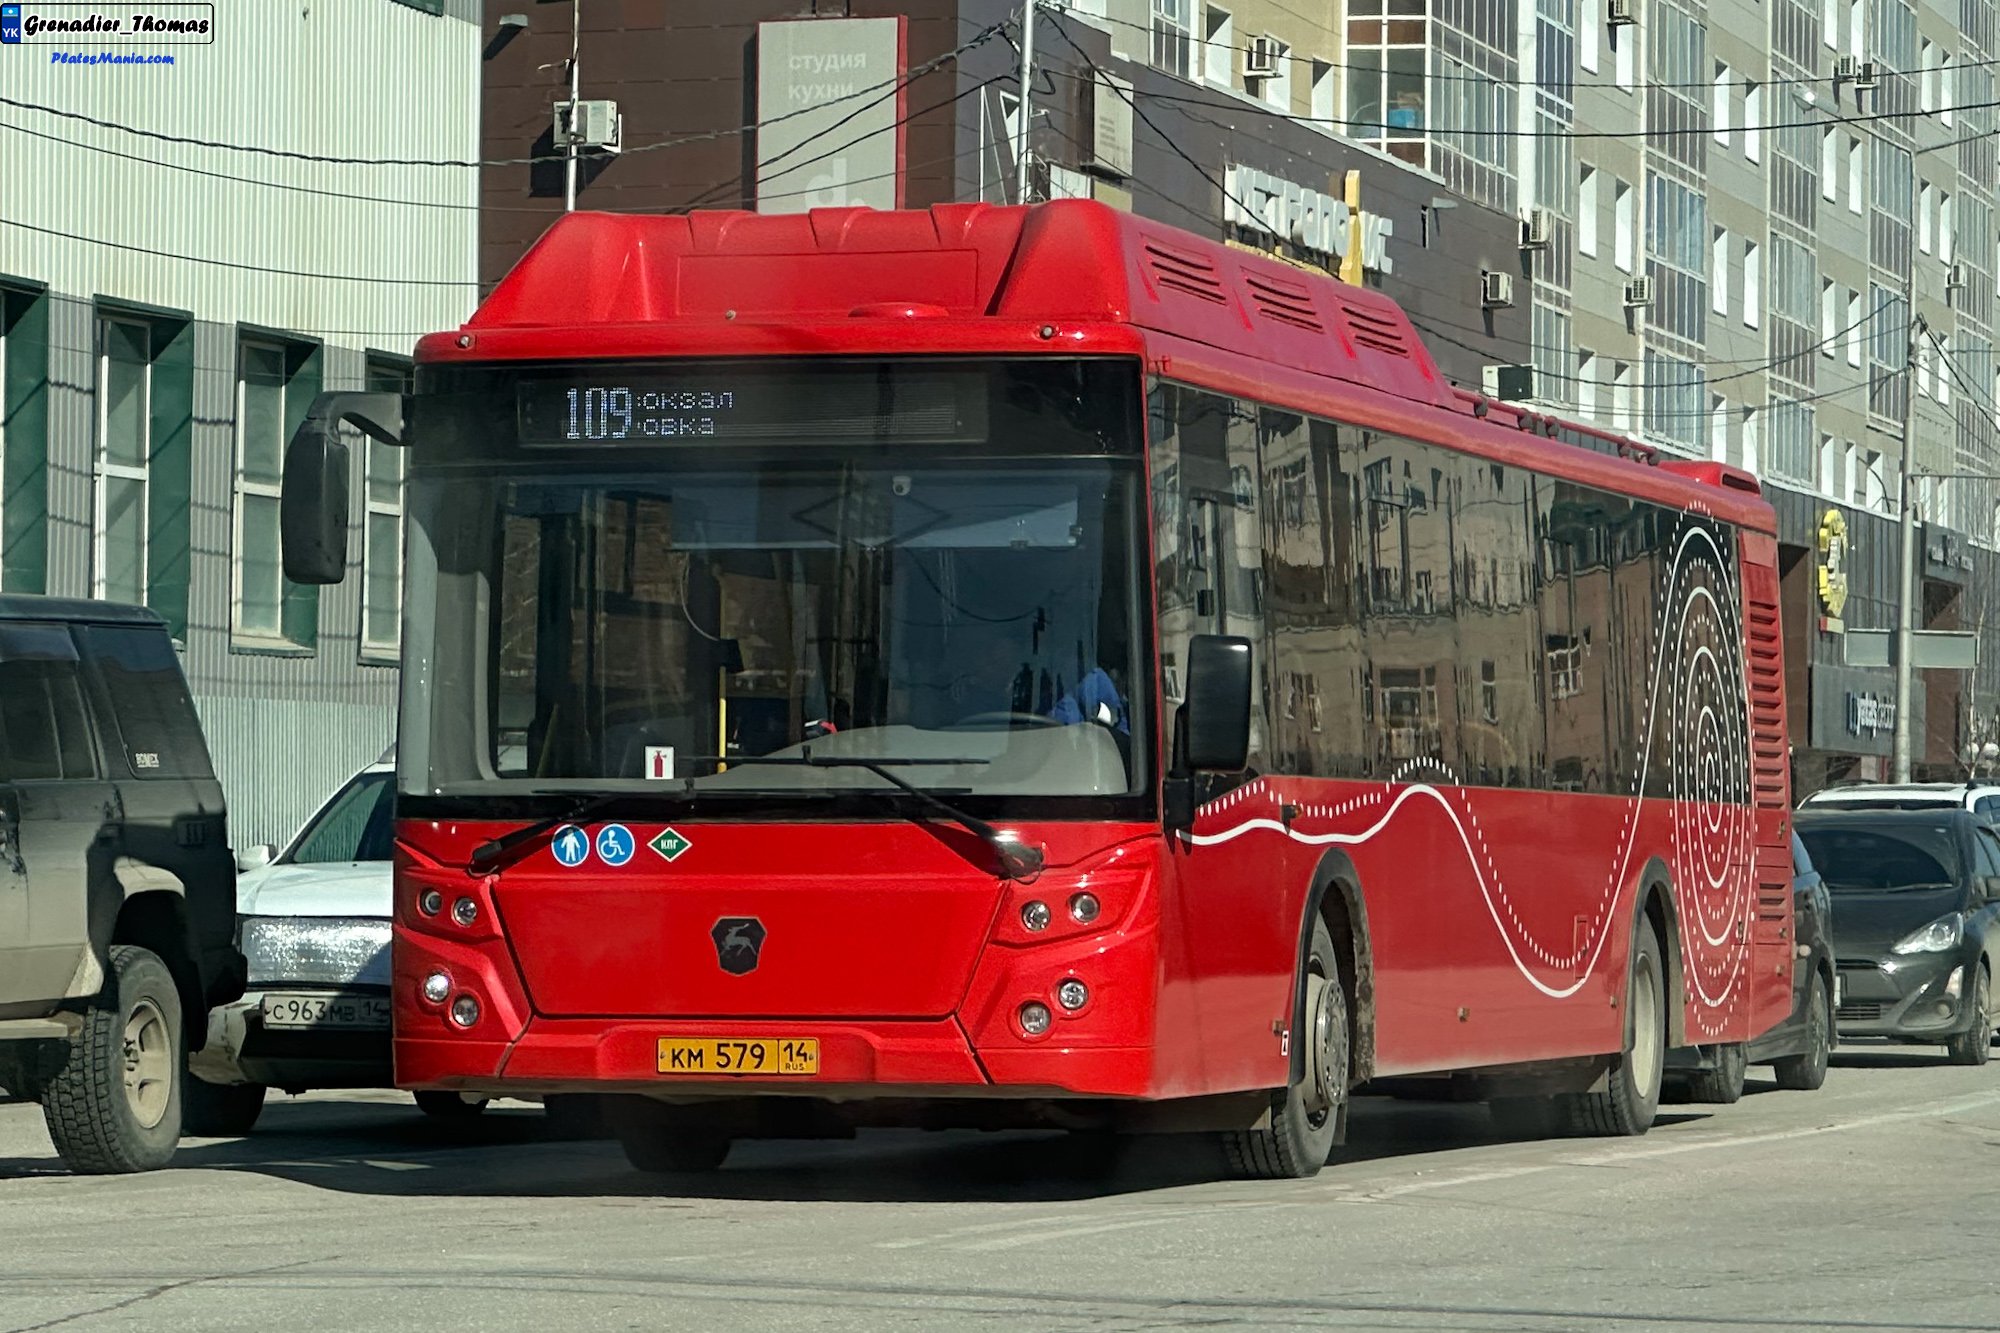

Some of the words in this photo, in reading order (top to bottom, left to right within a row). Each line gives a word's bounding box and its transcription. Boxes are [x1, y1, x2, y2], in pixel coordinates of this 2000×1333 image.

[788, 52, 867, 71] студия
[788, 82, 854, 104] кухни
[566, 387, 633, 440] 109
[660, 839, 679, 850] КПГ
[671, 1048, 704, 1069] КМ
[715, 1042, 766, 1069] 579
[783, 1042, 808, 1062] 14
[785, 1062, 805, 1071] RUS
